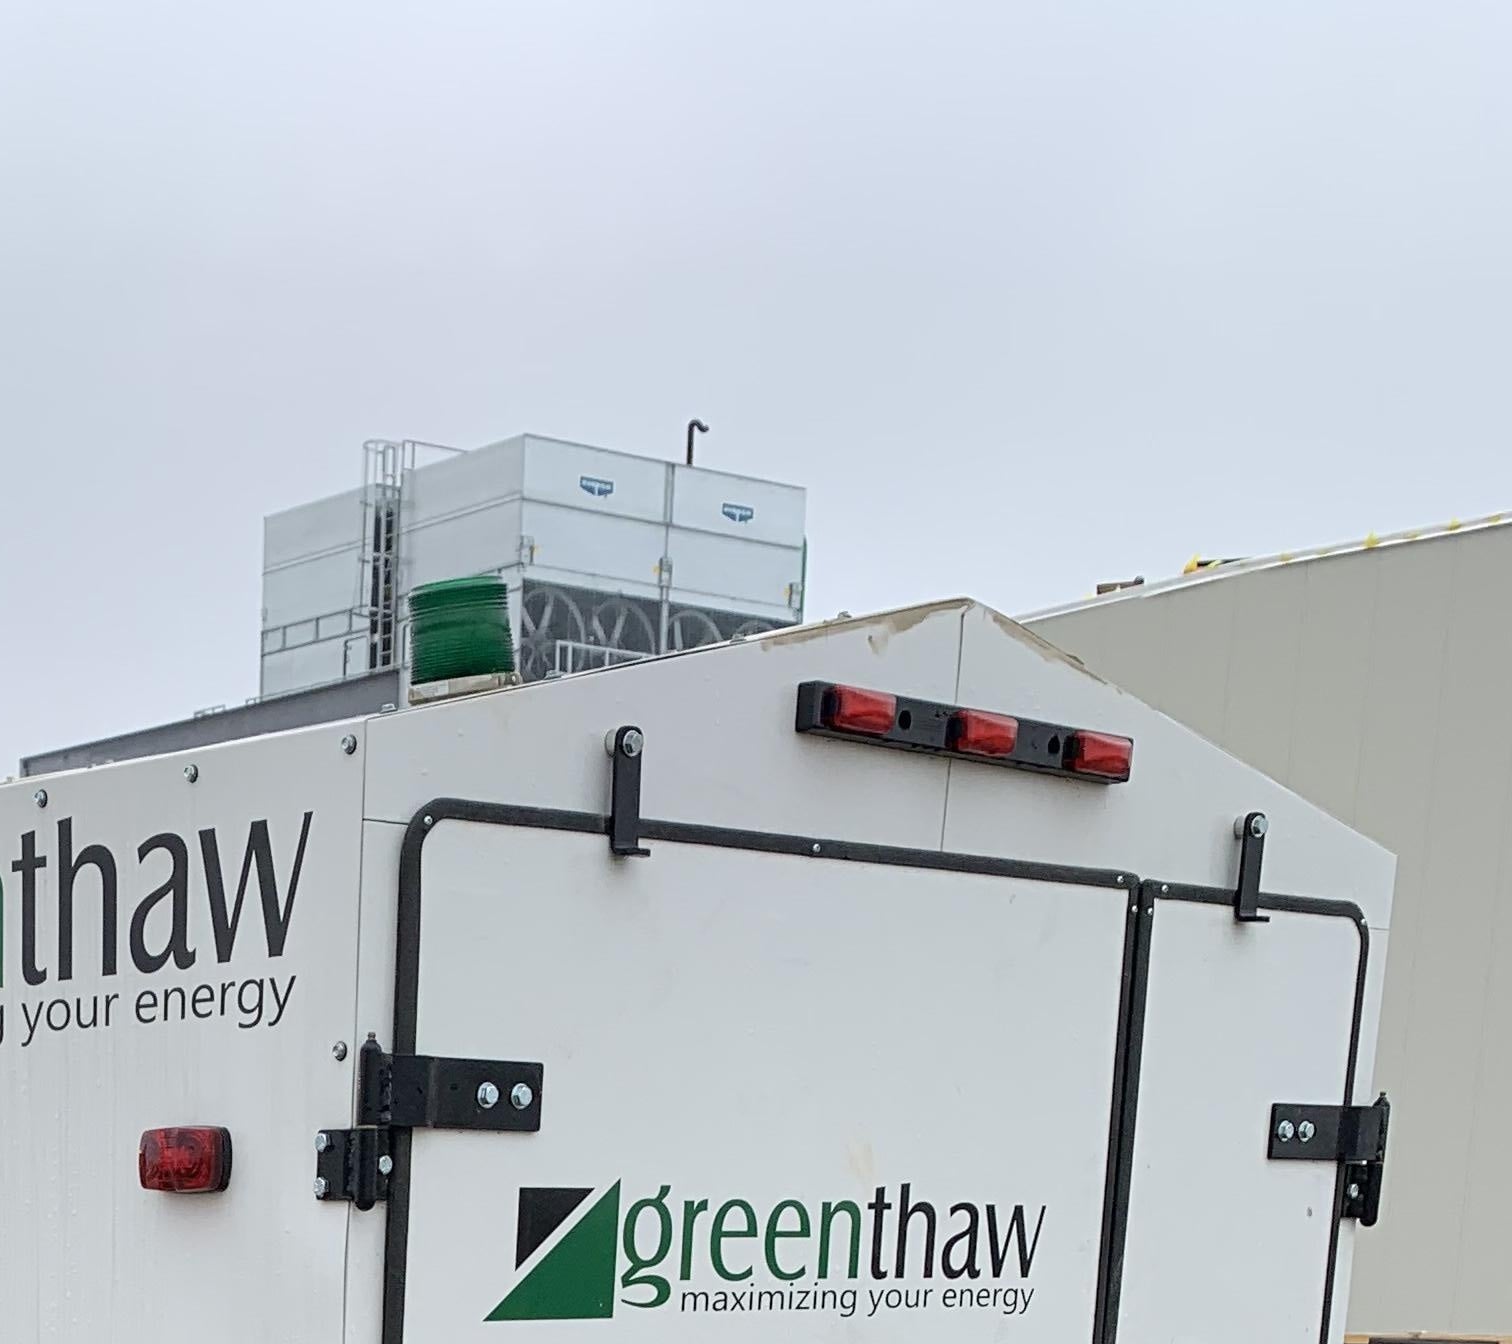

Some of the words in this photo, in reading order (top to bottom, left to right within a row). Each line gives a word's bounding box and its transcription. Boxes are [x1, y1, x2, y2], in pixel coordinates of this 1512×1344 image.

[21, 992, 120, 1047] your
[134, 974, 297, 1029] energy
[620, 1182, 1046, 1308] greenthaw
[680, 1282, 857, 1318] maximizing
[867, 1285, 934, 1317] your
[941, 1284, 1035, 1315] energy
